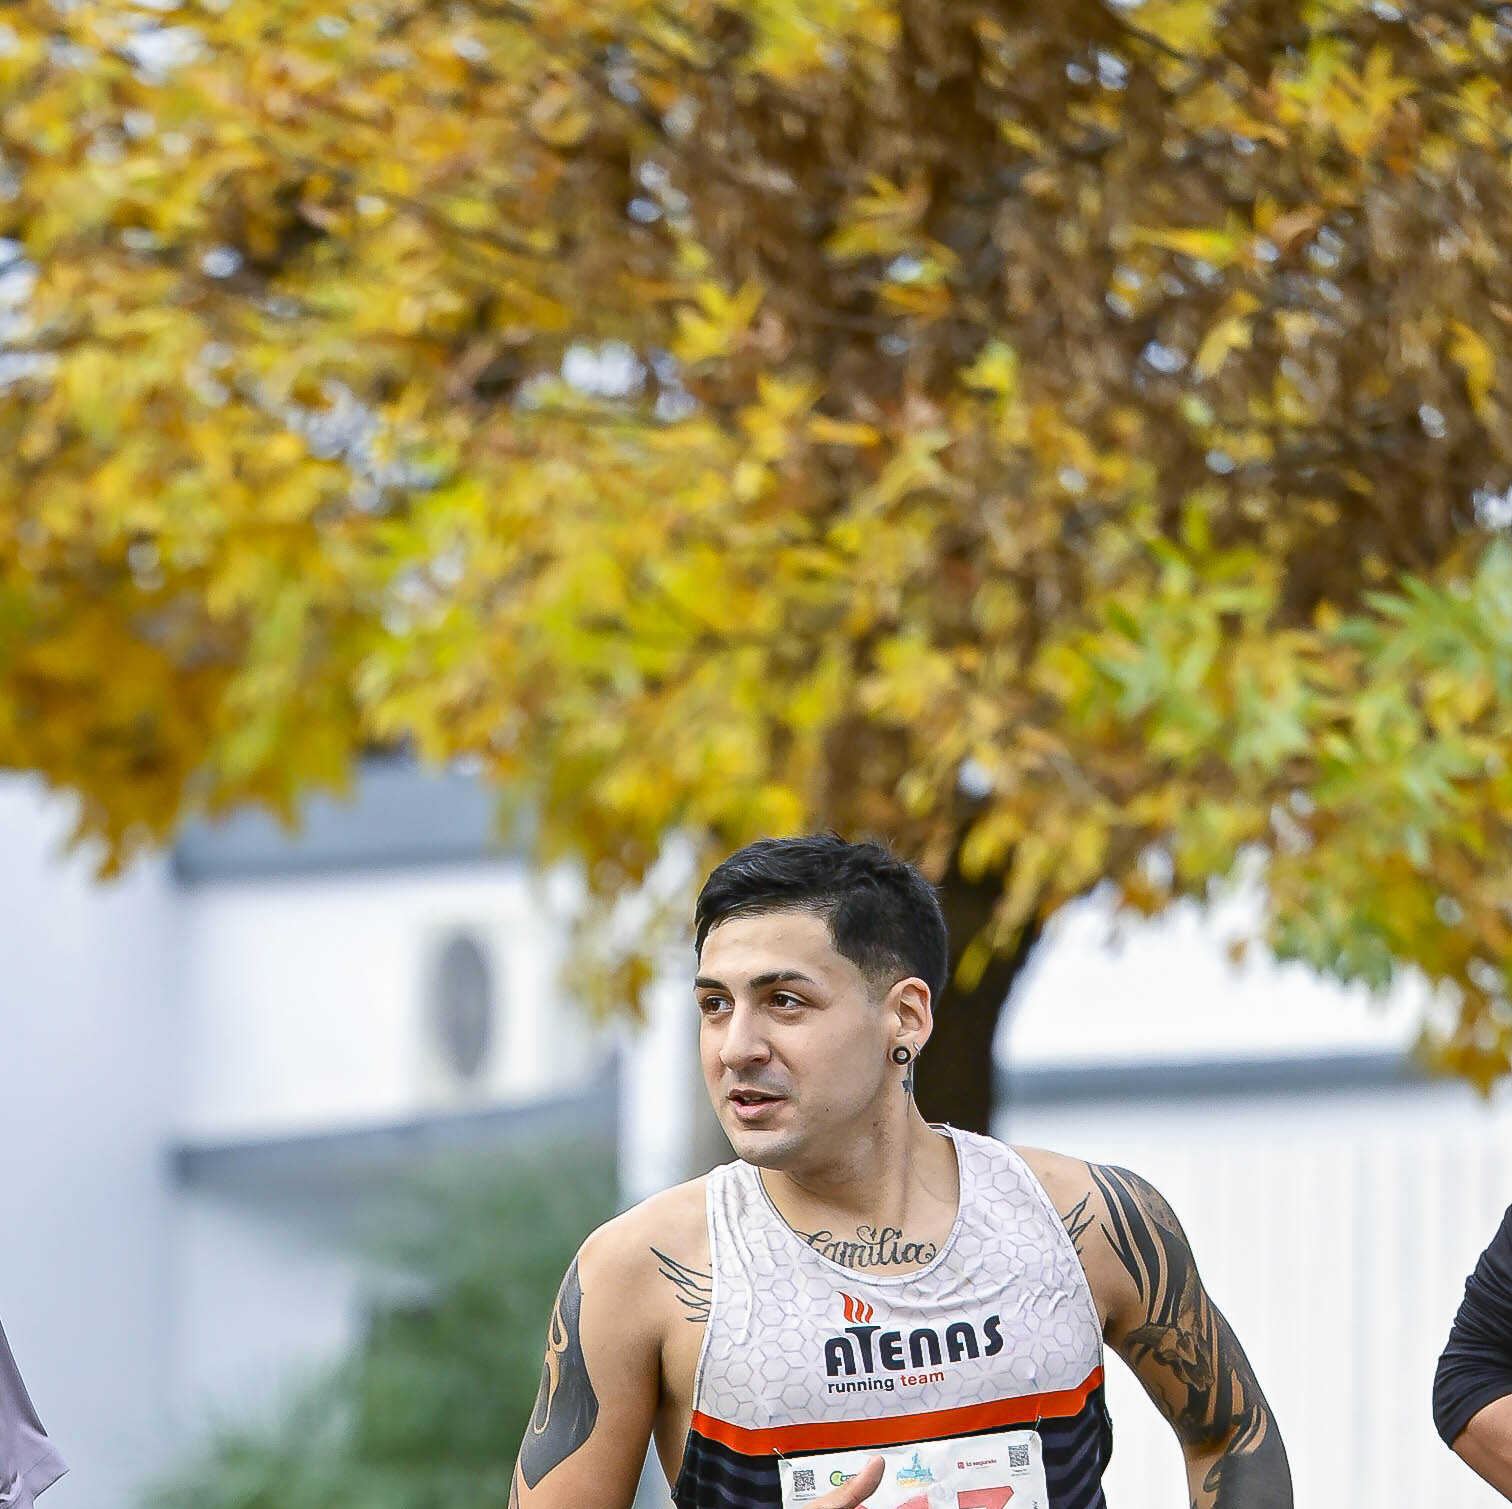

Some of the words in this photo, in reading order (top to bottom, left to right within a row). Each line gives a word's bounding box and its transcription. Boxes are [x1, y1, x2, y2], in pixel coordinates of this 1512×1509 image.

[824, 1315, 1004, 1377] ATENAS
[828, 1377, 894, 1394] running
[900, 1371, 945, 1387] team
